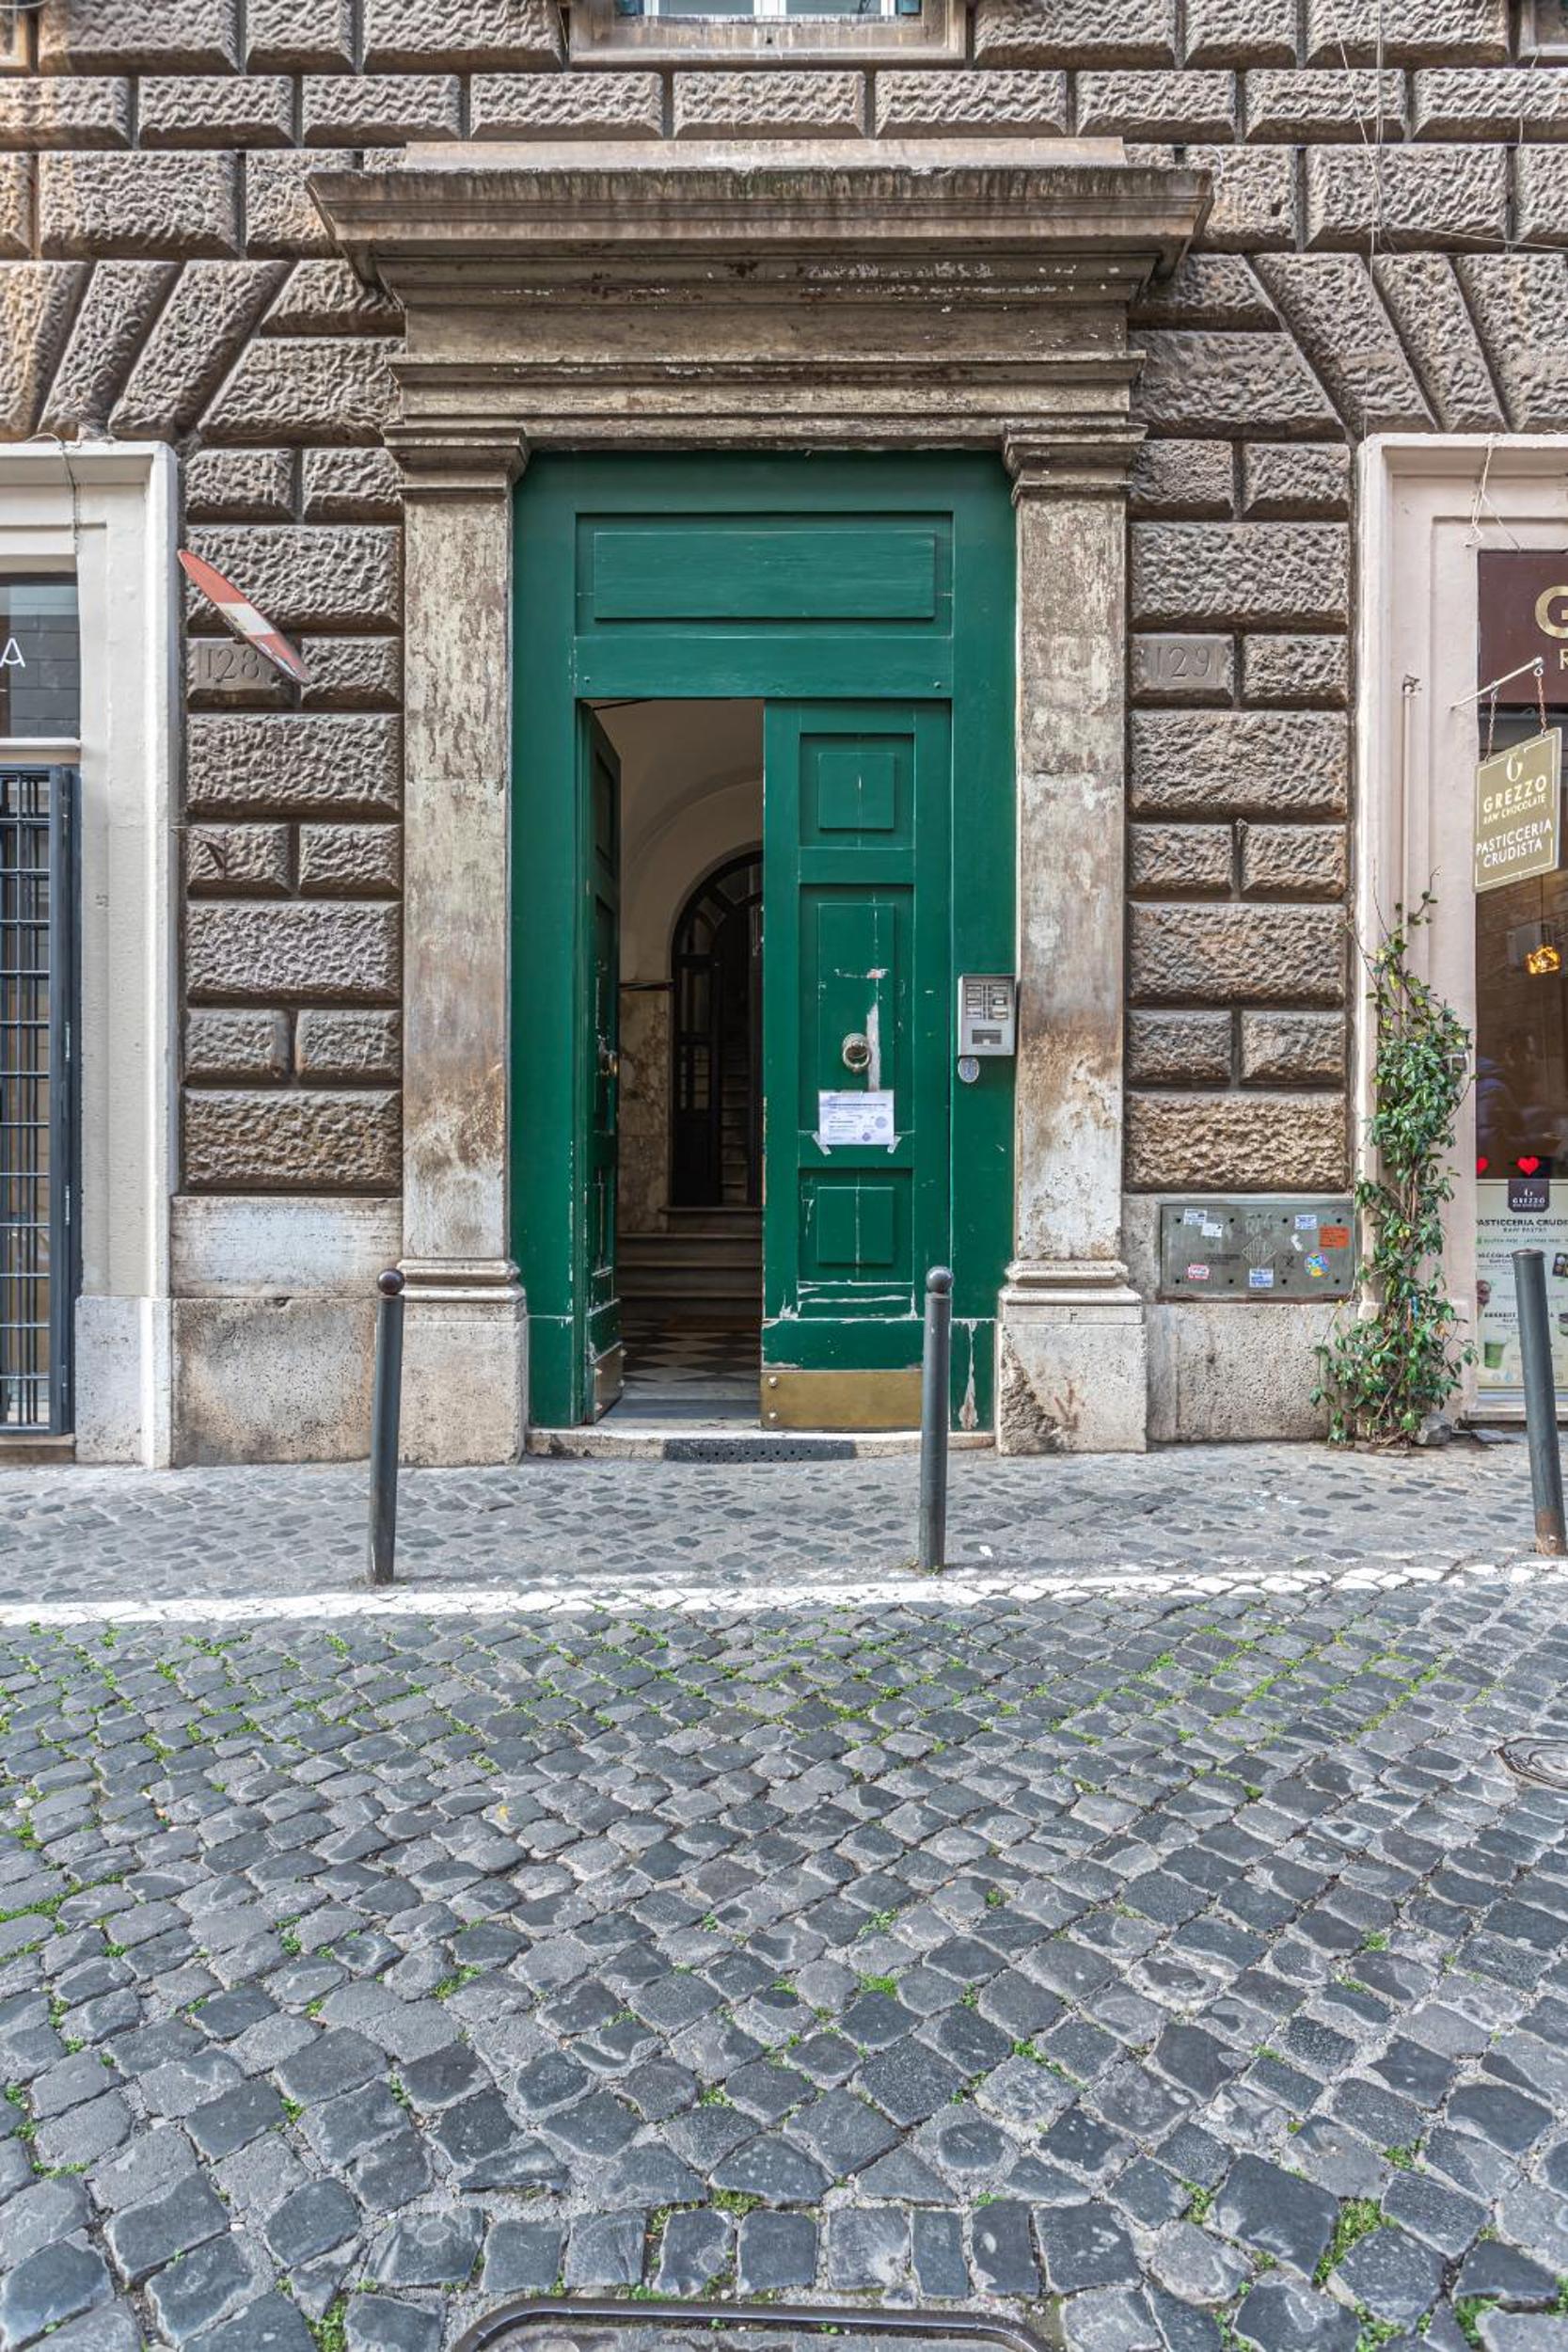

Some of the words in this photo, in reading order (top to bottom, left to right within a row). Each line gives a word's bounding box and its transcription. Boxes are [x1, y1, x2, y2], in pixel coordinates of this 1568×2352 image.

[207, 648, 261, 681] 128
[1157, 645, 1211, 678] 129
[1482, 774, 1547, 814] GREZZO
[1482, 809, 1500, 825] RAW
[1501, 792, 1546, 818] CHOCOLATE
[1476, 818, 1553, 856] PASTICCERIA
[1483, 836, 1544, 868] CRUDISTA
